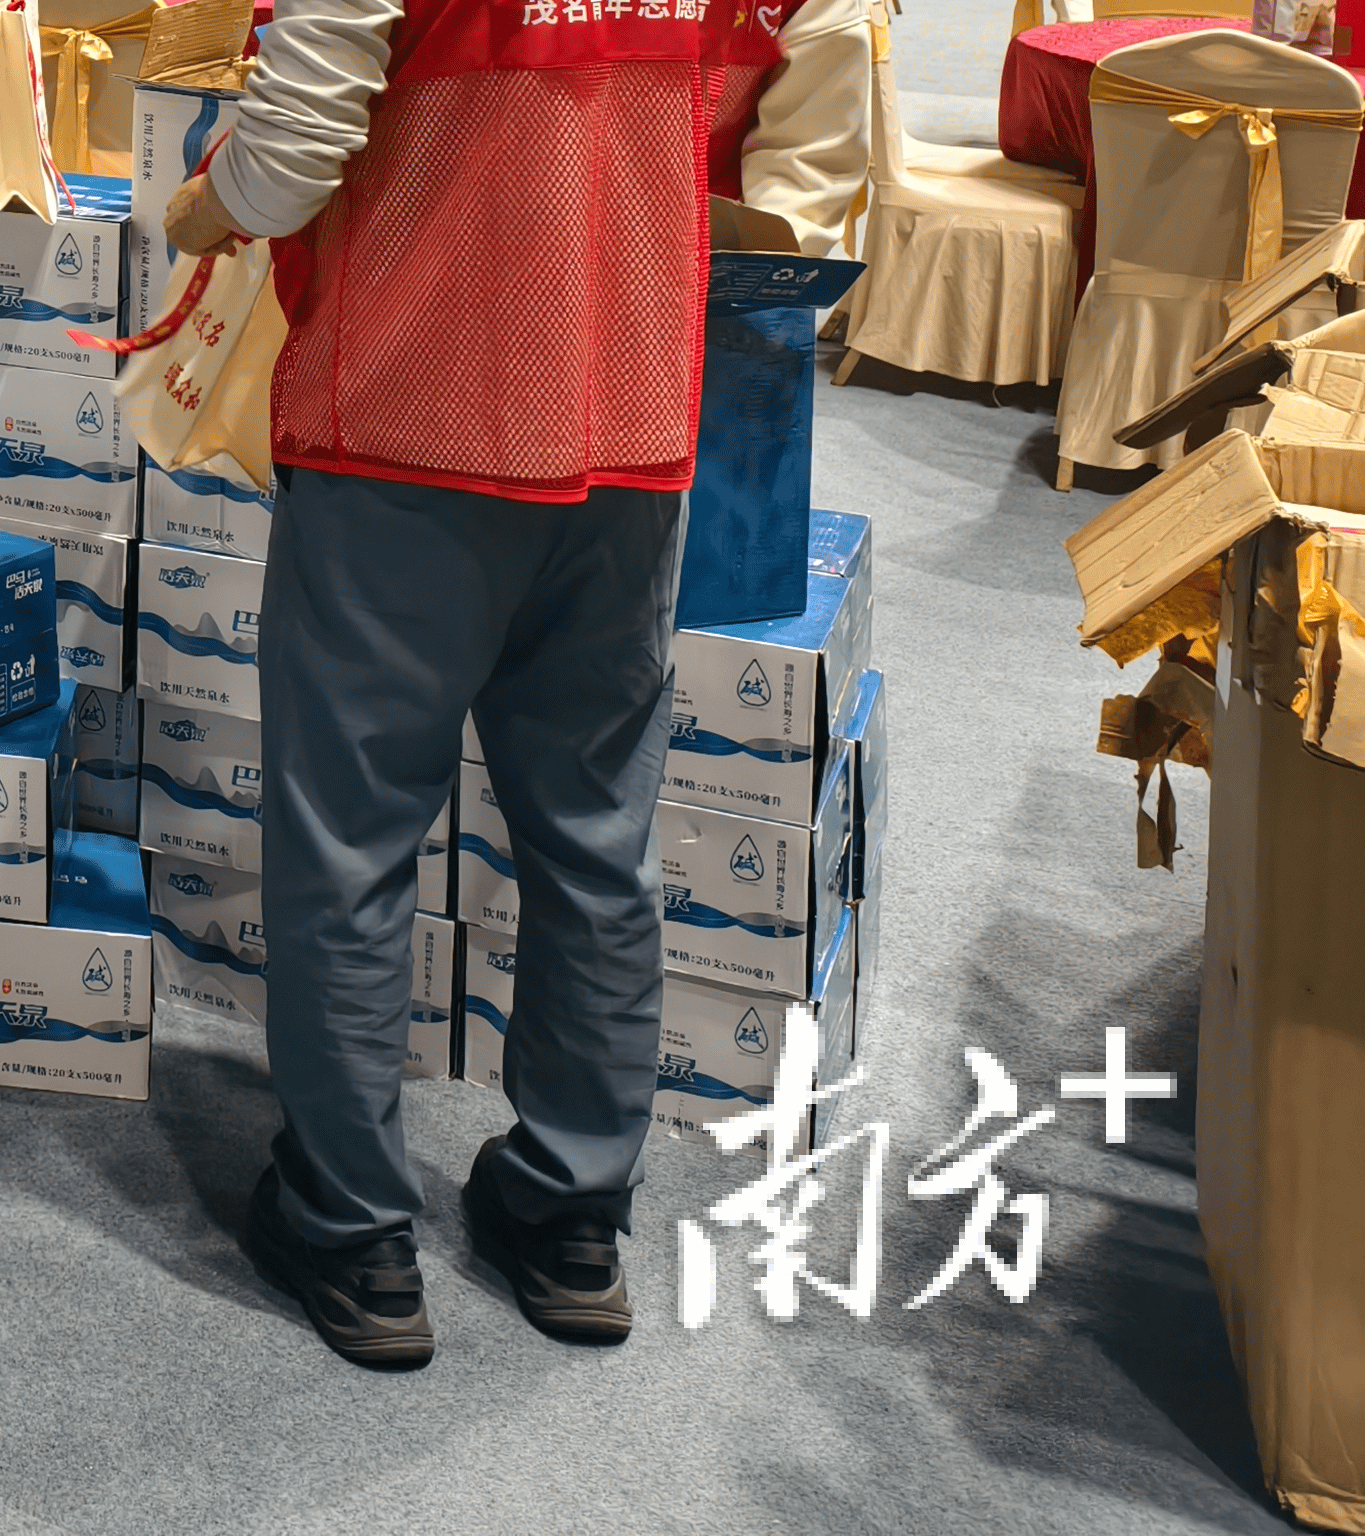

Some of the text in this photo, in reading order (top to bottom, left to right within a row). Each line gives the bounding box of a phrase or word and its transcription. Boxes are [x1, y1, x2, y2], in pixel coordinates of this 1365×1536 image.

[165, 520, 236, 543] 饮用天然泉水
[160, 681, 231, 705] 饮用天然泉水
[160, 832, 230, 857] 饮用天然泉水
[169, 984, 237, 1012] 饮用天然泉水
